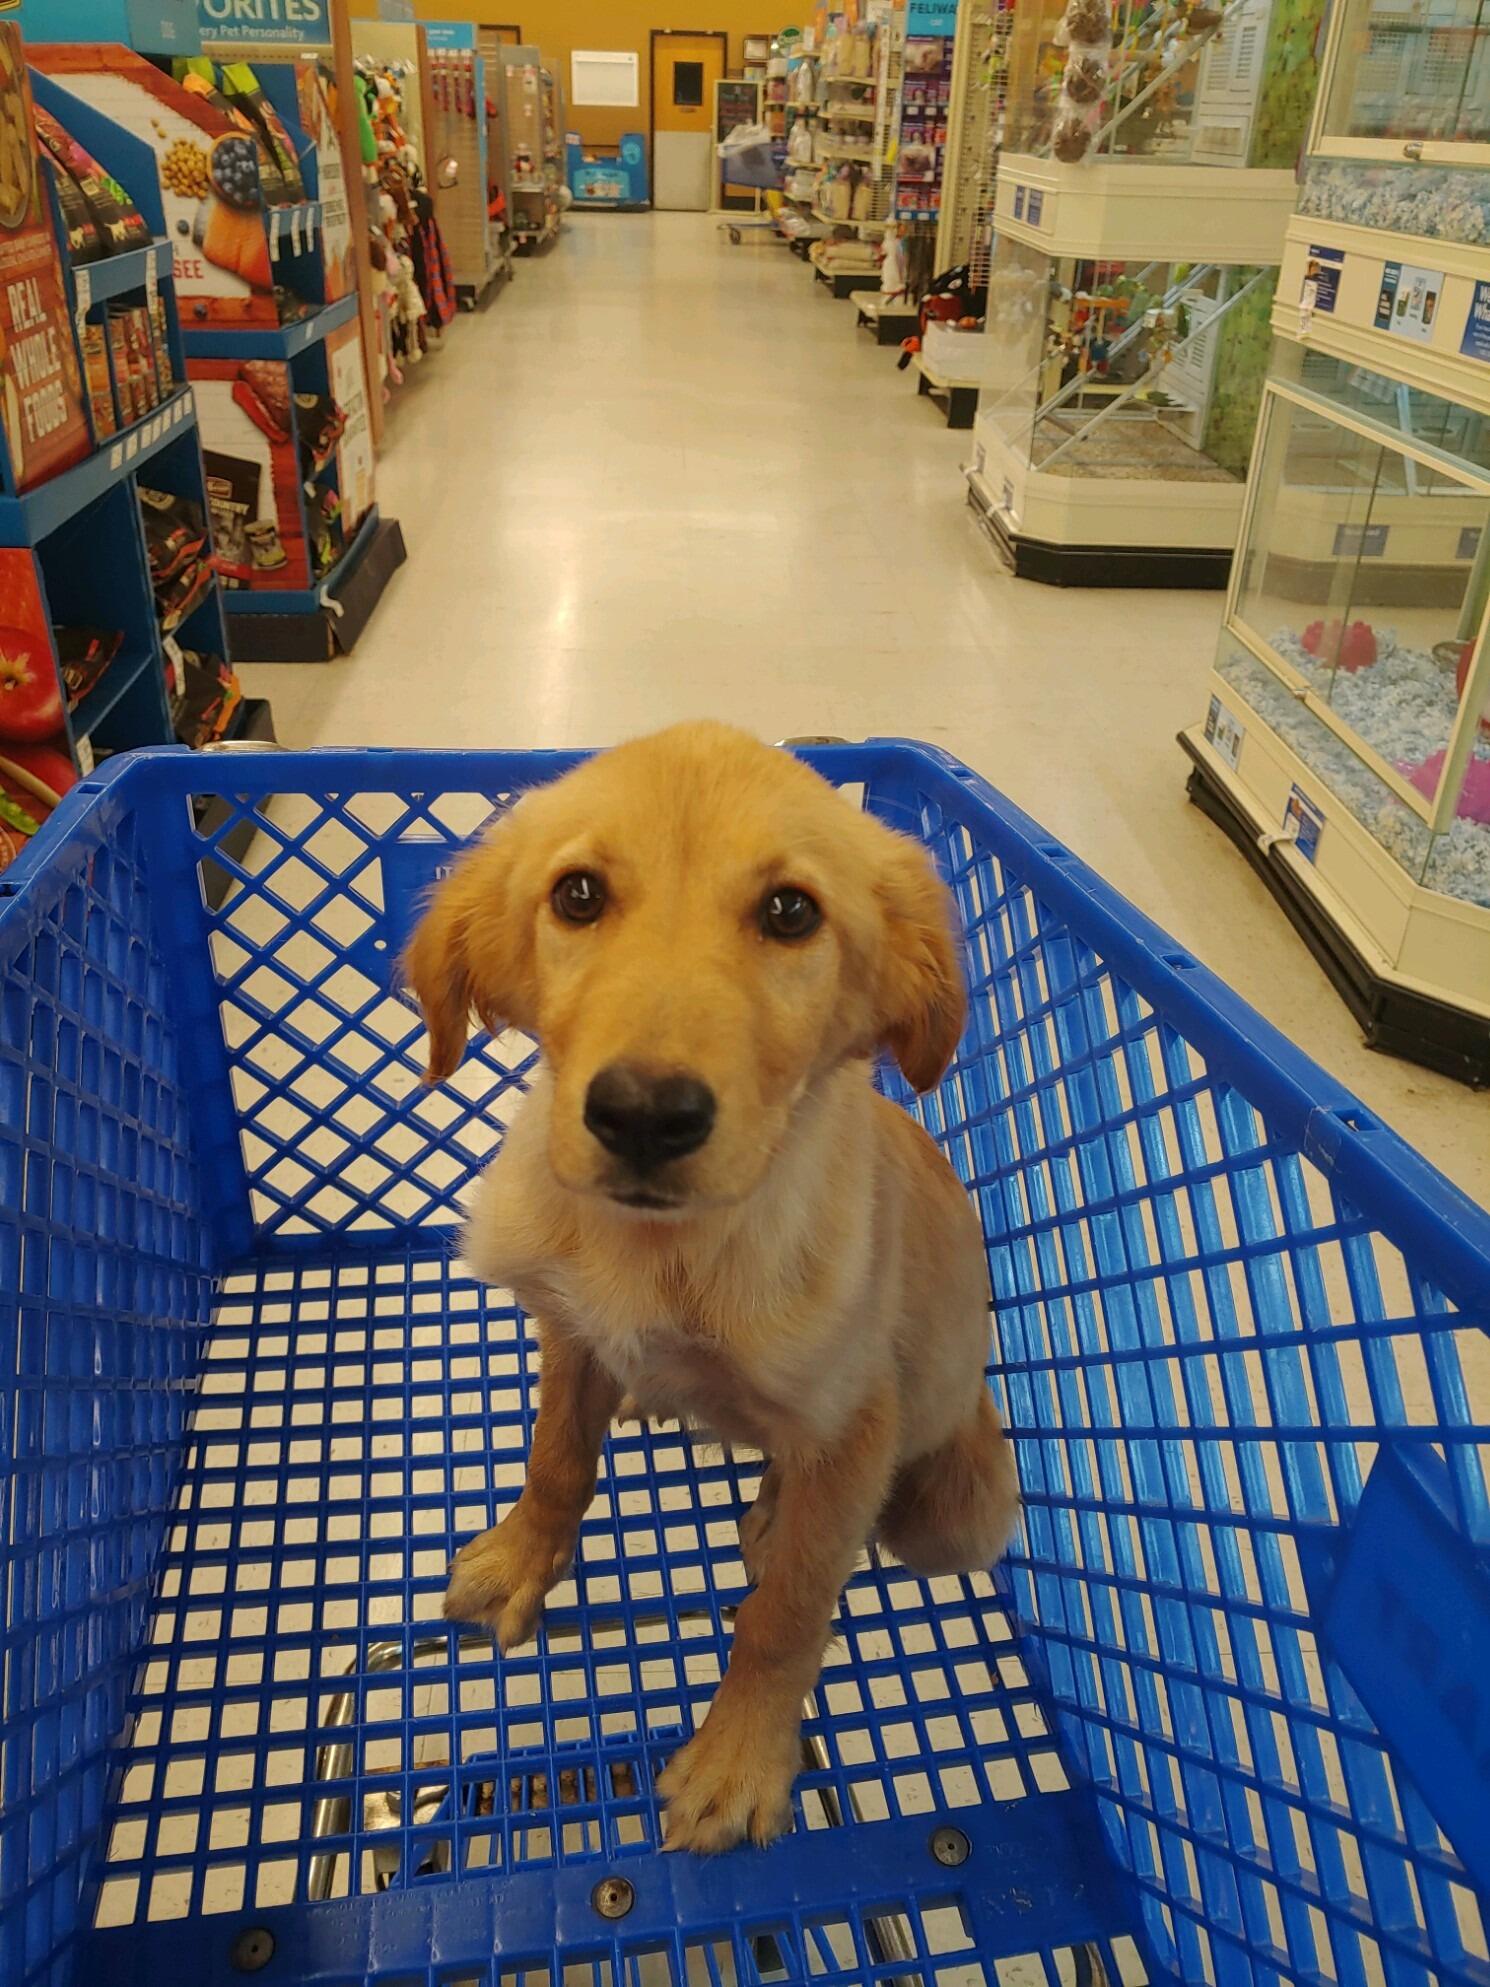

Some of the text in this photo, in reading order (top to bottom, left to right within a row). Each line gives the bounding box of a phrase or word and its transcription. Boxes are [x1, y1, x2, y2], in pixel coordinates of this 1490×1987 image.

[199, 0, 321, 21] ORITES
[220, 24, 240, 37] Pet
[241, 24, 304, 41] Personality
[173, 259, 204, 279] SEE
[7, 276, 47, 333] REAL
[10, 326, 61, 390] WHOLE
[23, 379, 68, 443] FOODS
